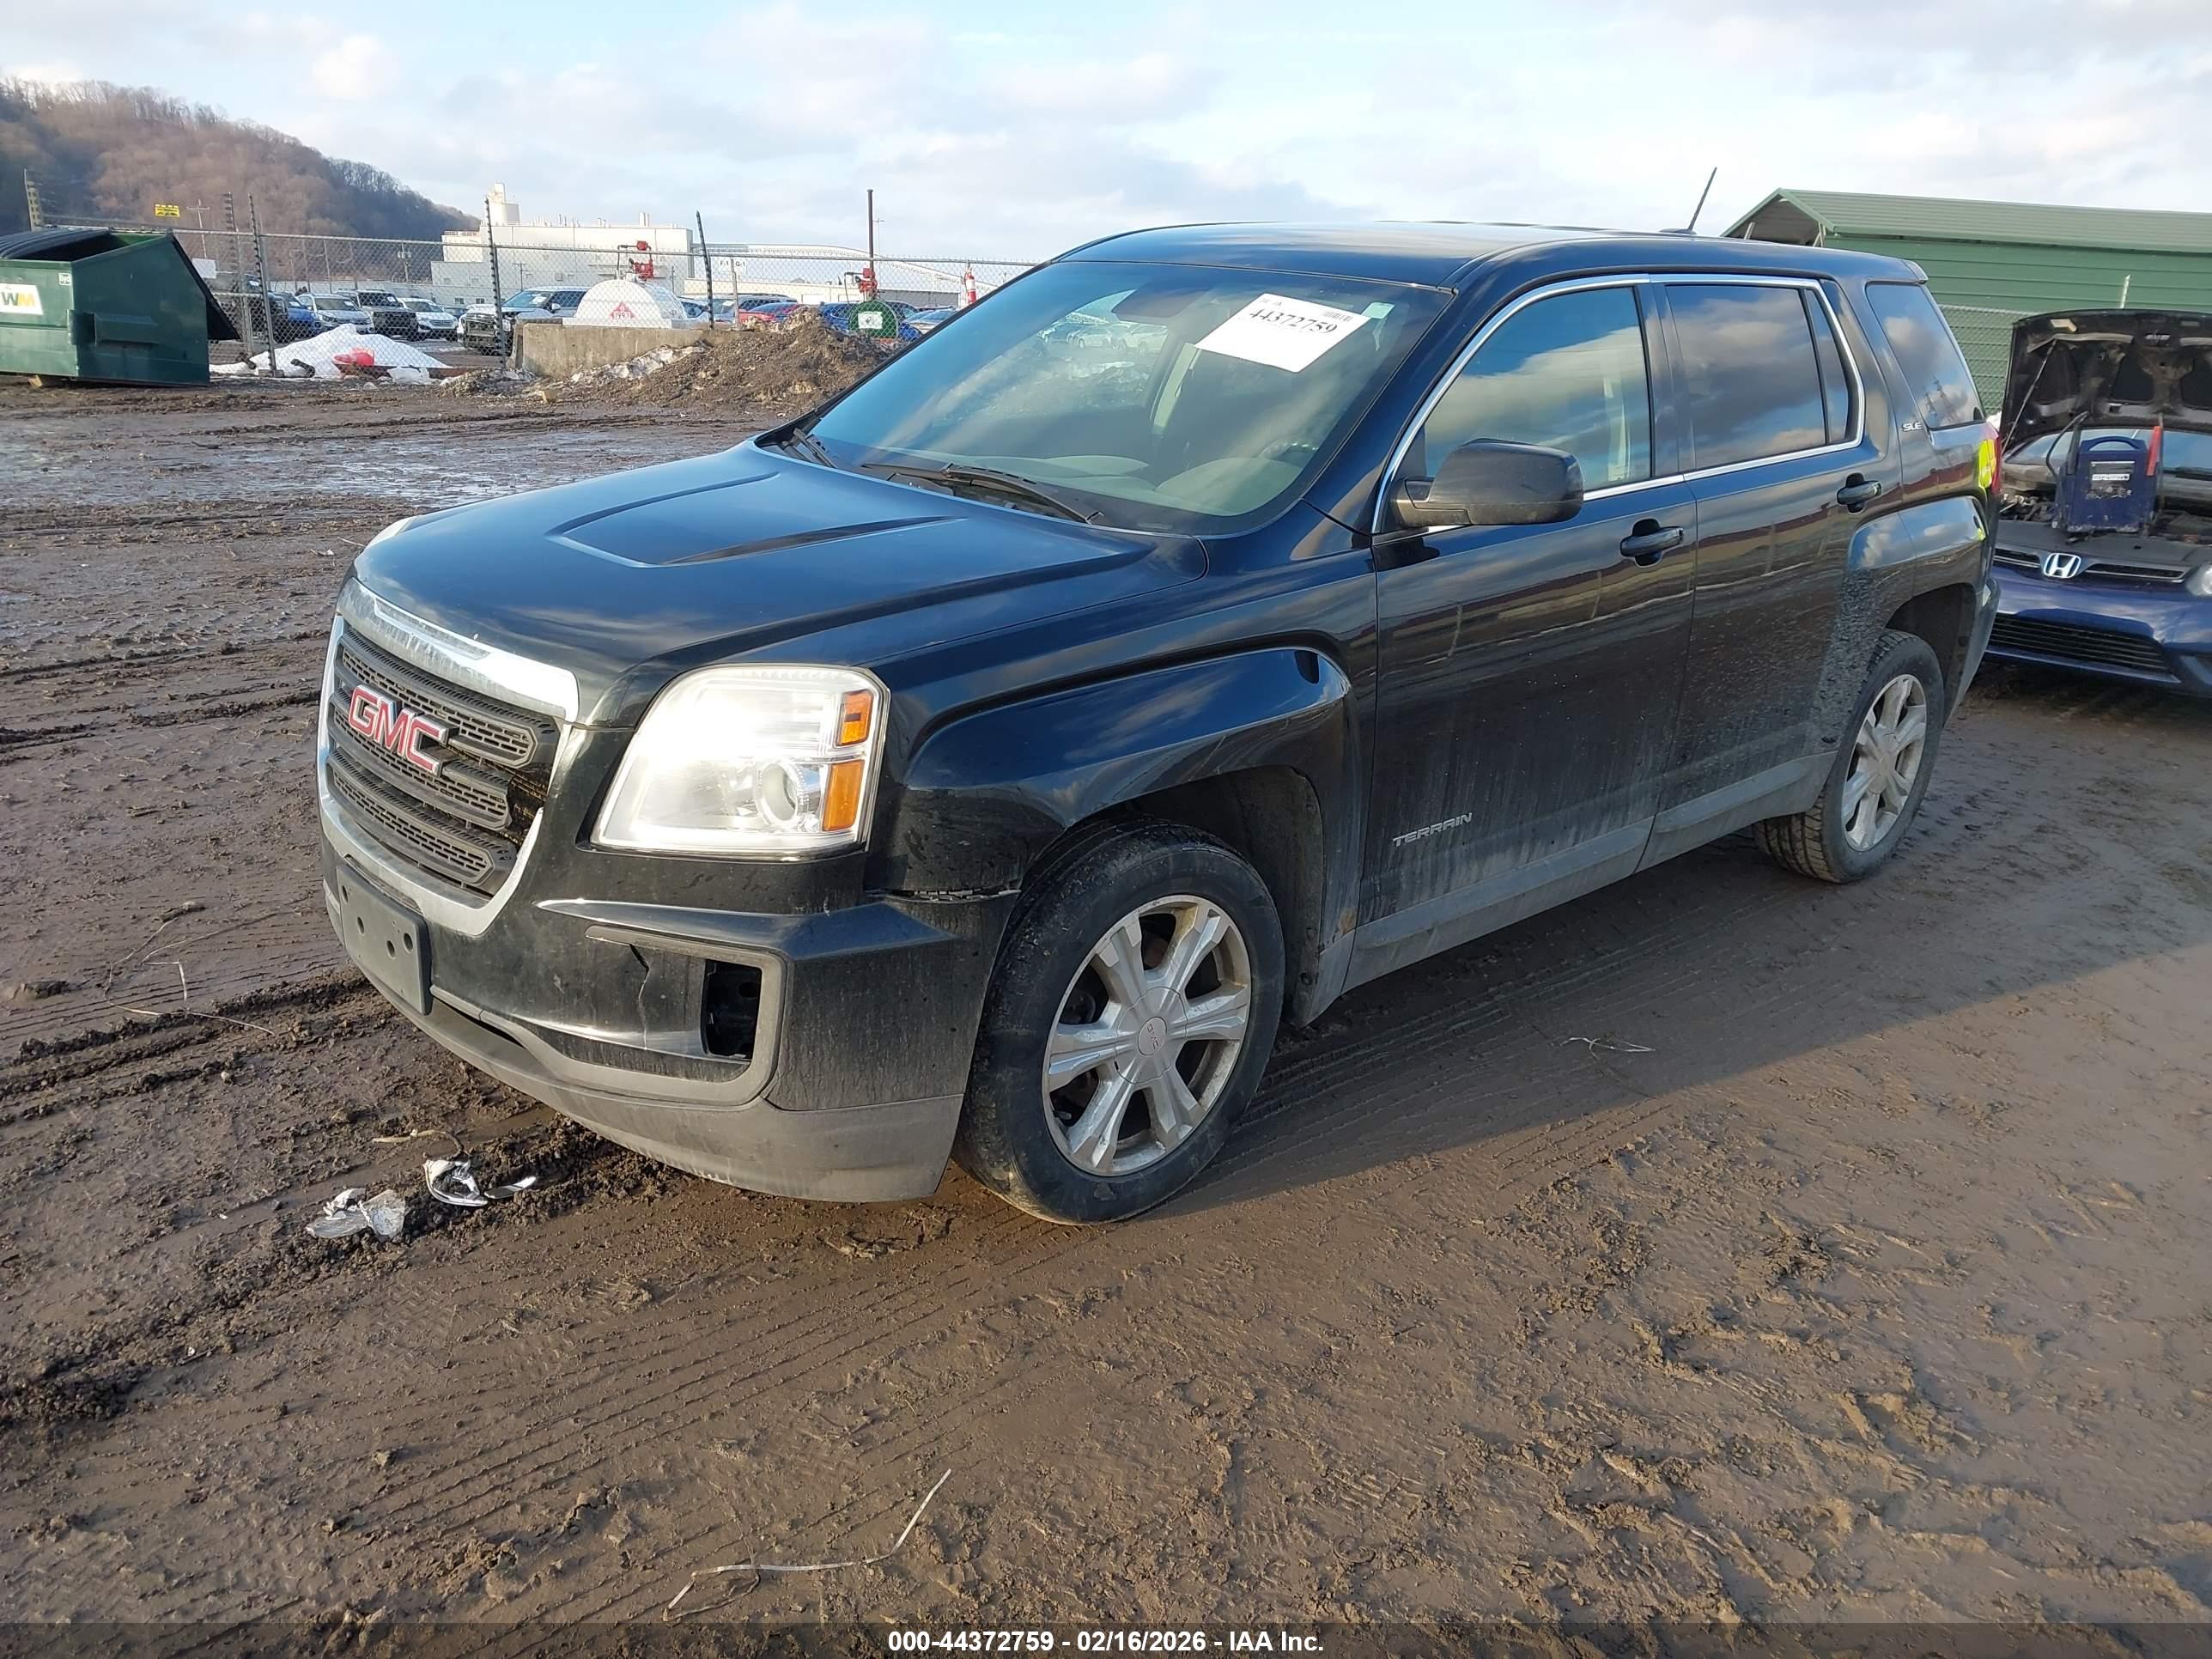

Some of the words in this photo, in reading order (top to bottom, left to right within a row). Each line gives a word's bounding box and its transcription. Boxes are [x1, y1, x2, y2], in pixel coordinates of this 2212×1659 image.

[1, 292, 35, 307] WM
[1249, 307, 1339, 334] 44372759
[1902, 422, 1923, 432] SLE
[348, 685, 449, 776] GMC
[1392, 811, 1474, 848] TERRAIN
[1146, 1023, 1159, 1050] GMC
